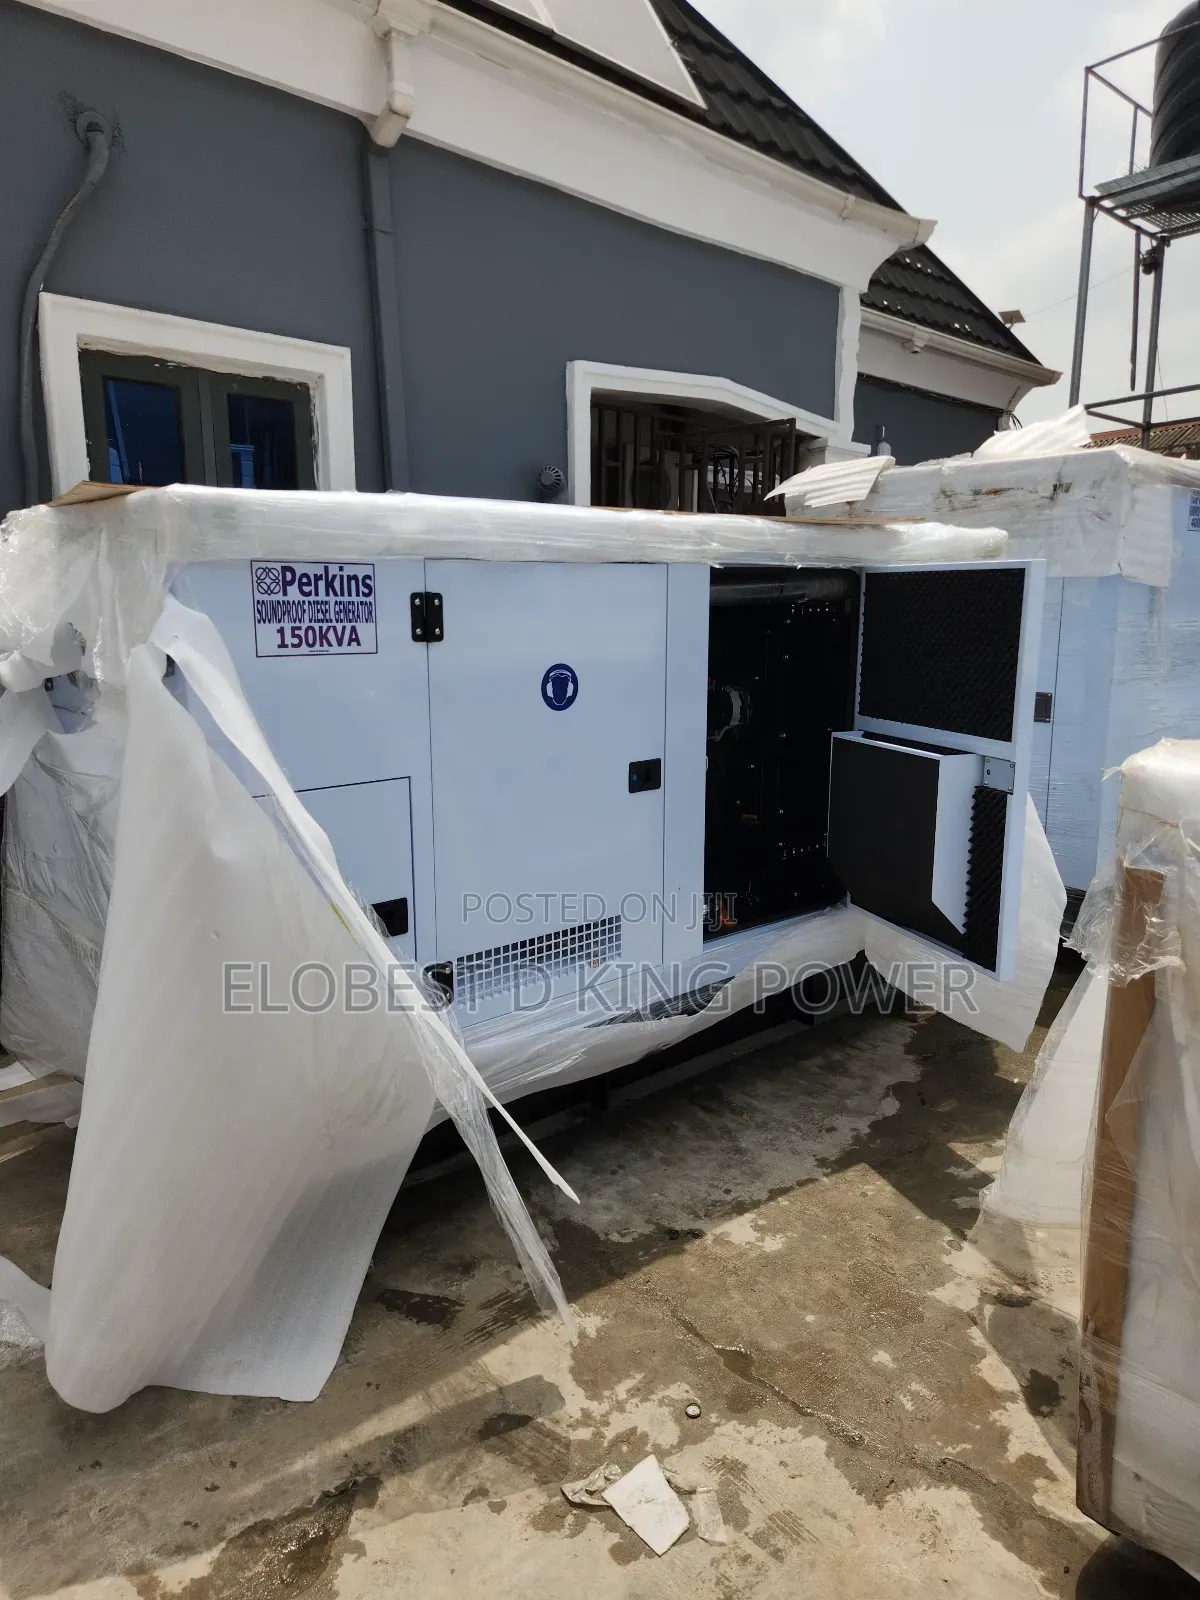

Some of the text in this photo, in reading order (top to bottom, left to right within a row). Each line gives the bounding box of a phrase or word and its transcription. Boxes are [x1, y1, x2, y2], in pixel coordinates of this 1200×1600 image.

[281, 565, 373, 598] Perkins
[256, 600, 374, 624] SOUNDPROOF DIESEL GENERATOR
[276, 625, 361, 649] 150KVA
